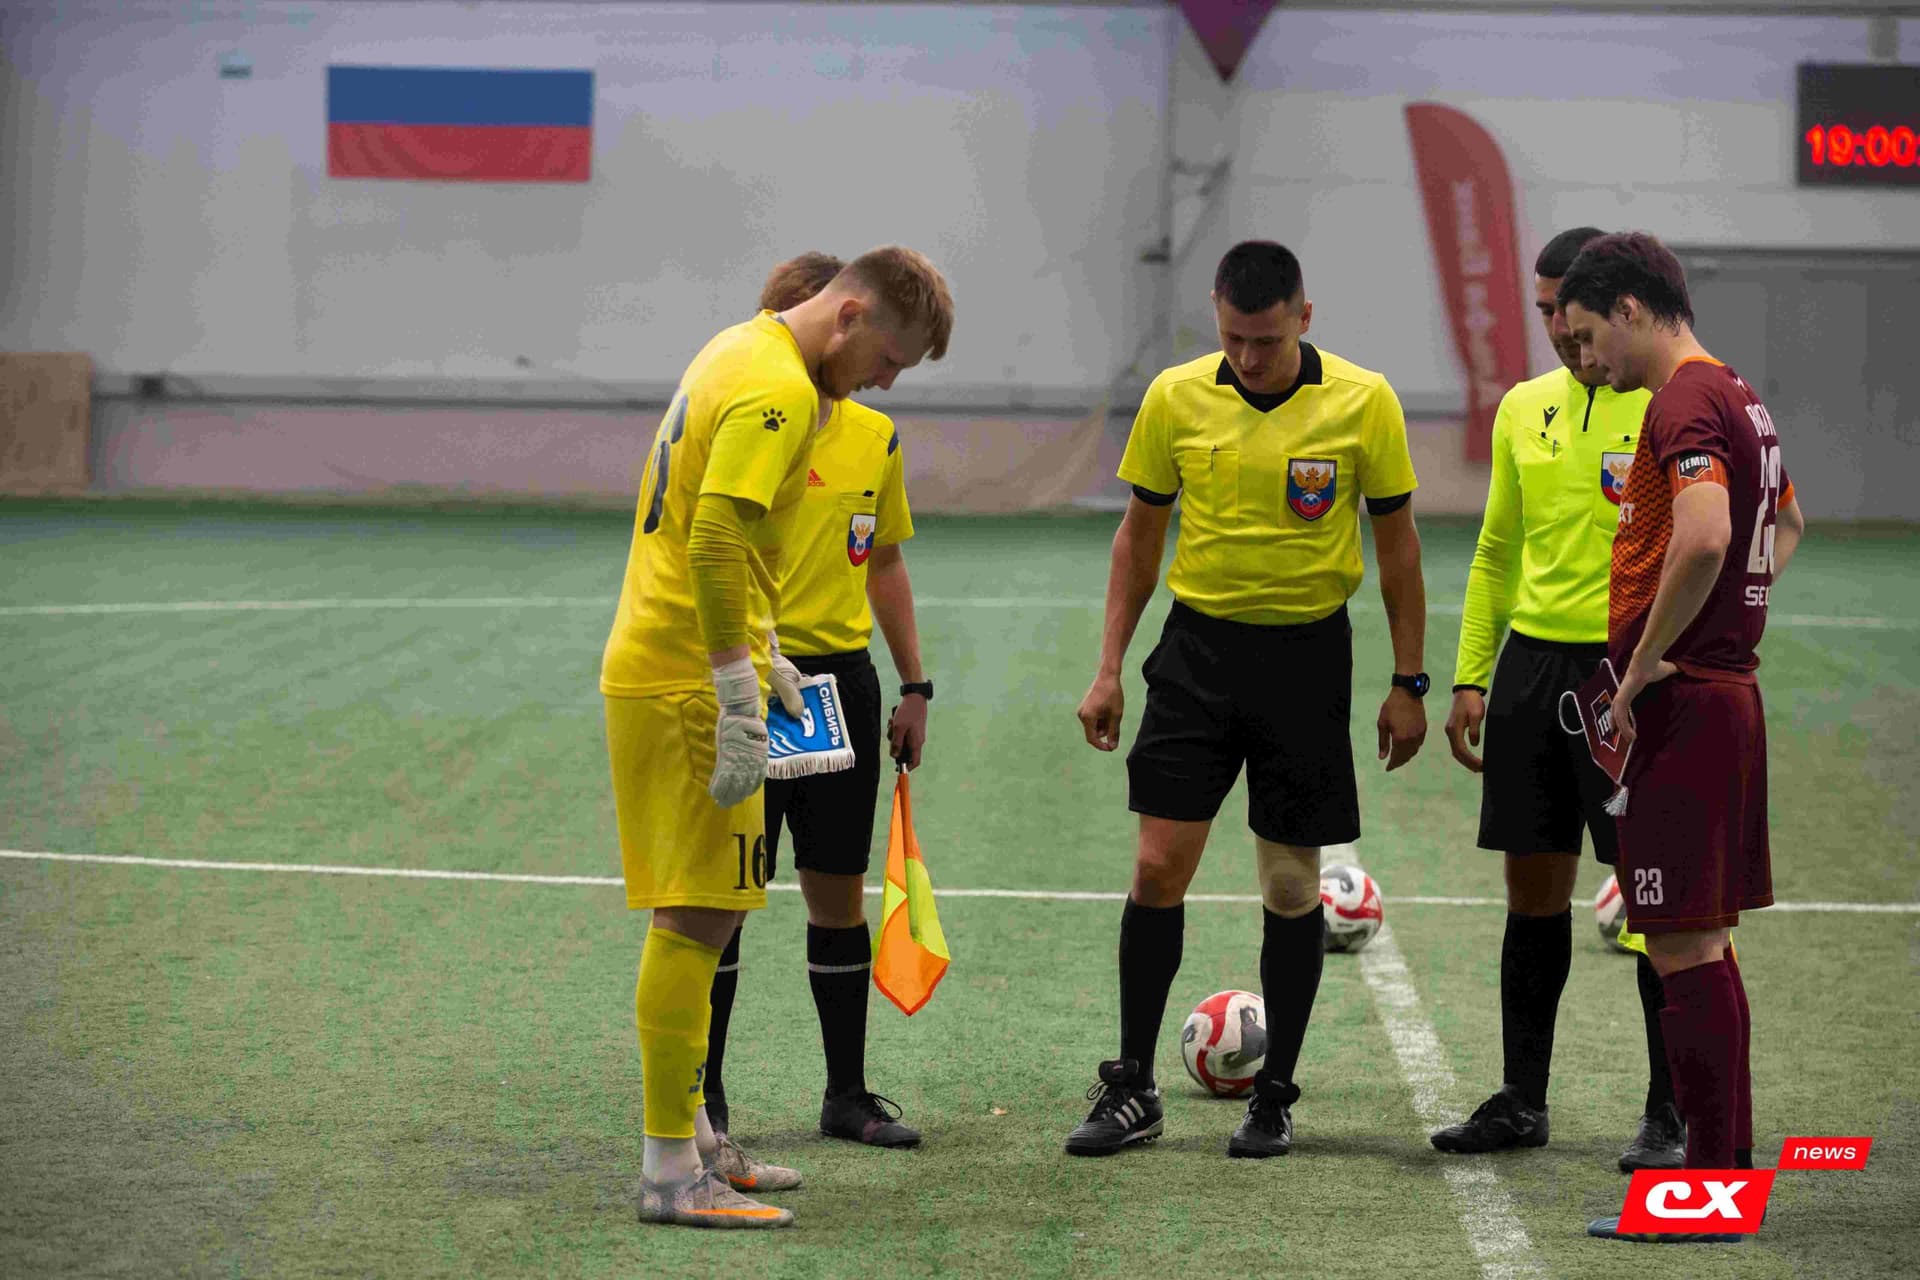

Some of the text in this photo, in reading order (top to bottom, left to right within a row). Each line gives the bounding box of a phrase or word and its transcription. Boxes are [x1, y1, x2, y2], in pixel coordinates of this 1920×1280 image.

[819, 686, 842, 747] СИБИРЬ
[732, 832, 766, 890] 16
[1634, 867, 1664, 906] 23
